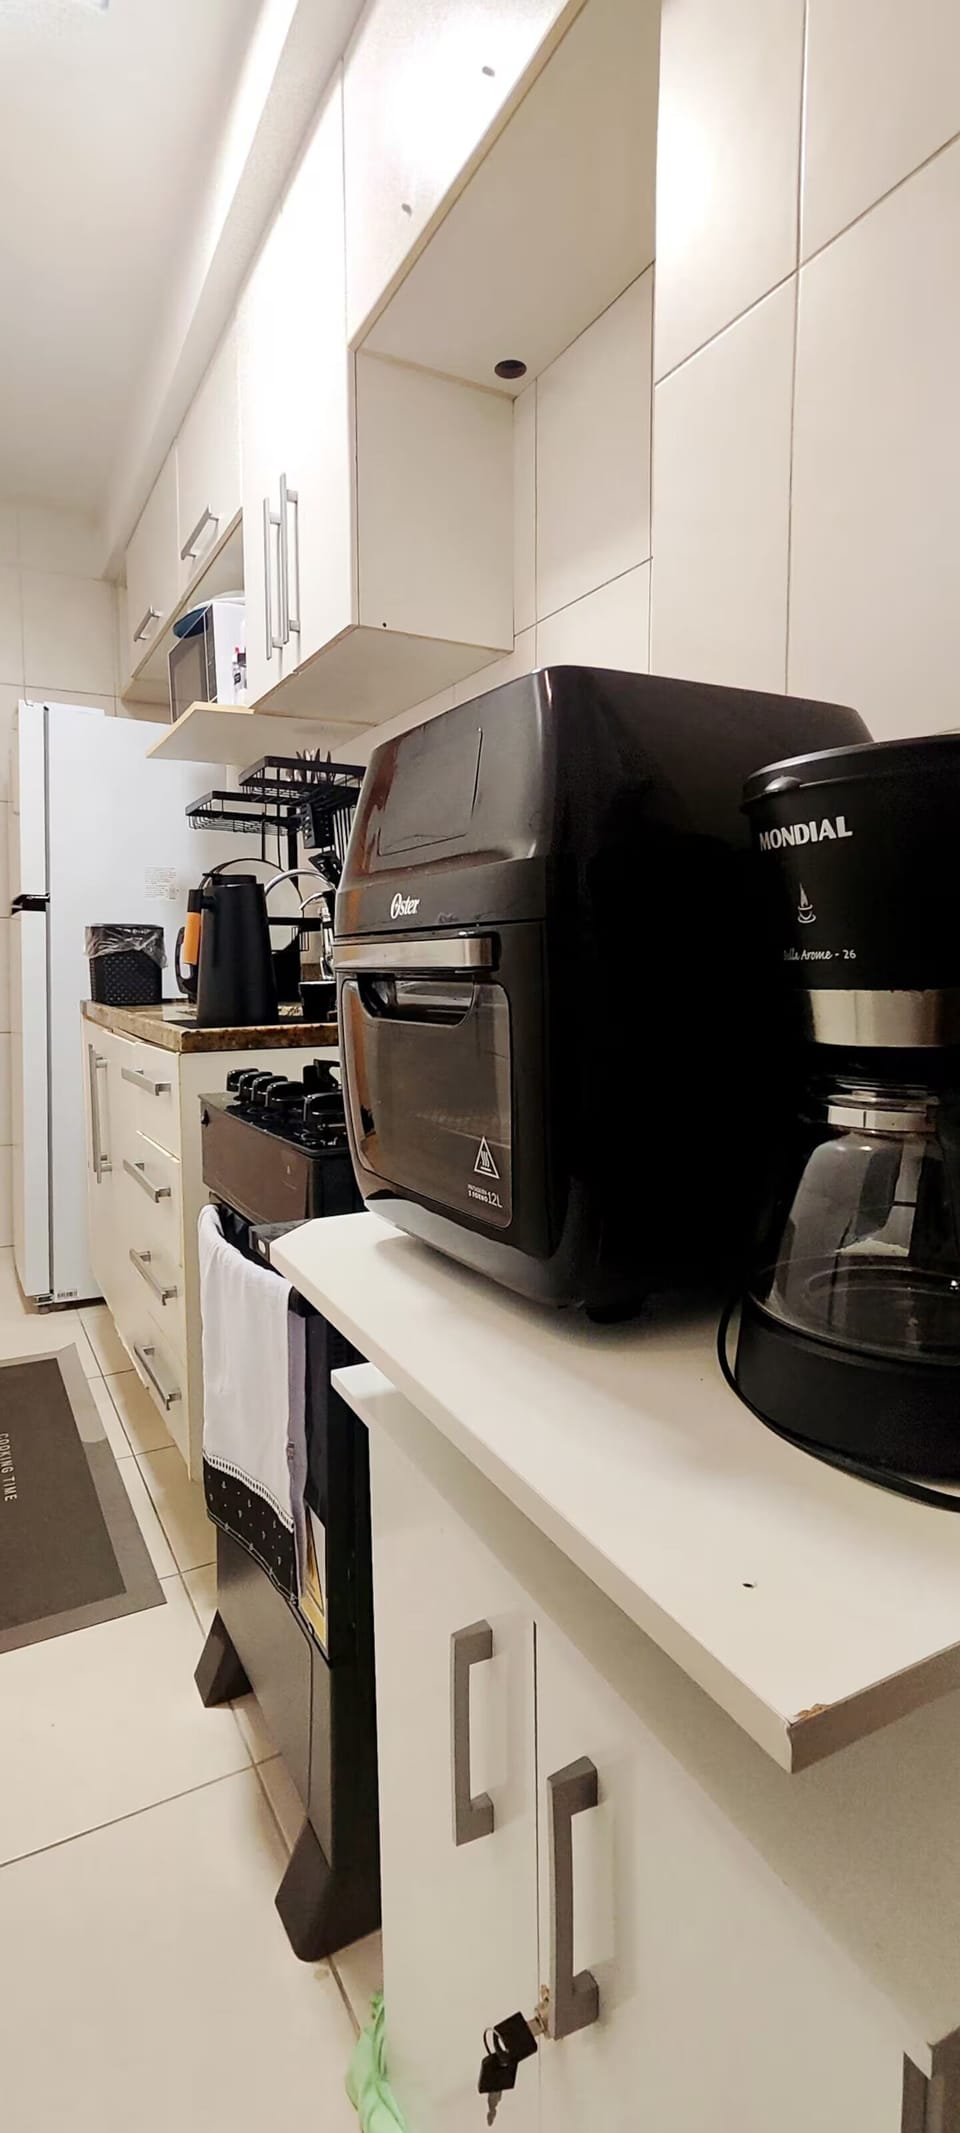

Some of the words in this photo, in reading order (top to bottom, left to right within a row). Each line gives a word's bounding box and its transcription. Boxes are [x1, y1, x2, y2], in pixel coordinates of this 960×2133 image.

[759, 816, 853, 851] MONDIAL
[391, 893, 420, 919] Oster
[800, 948, 833, 960] Arome
[841, 948, 857, 960] 26
[487, 1191, 503, 1208] 12L
[0, 1433, 14, 1473] COOKING
[3, 1475, 17, 1501] TIME
